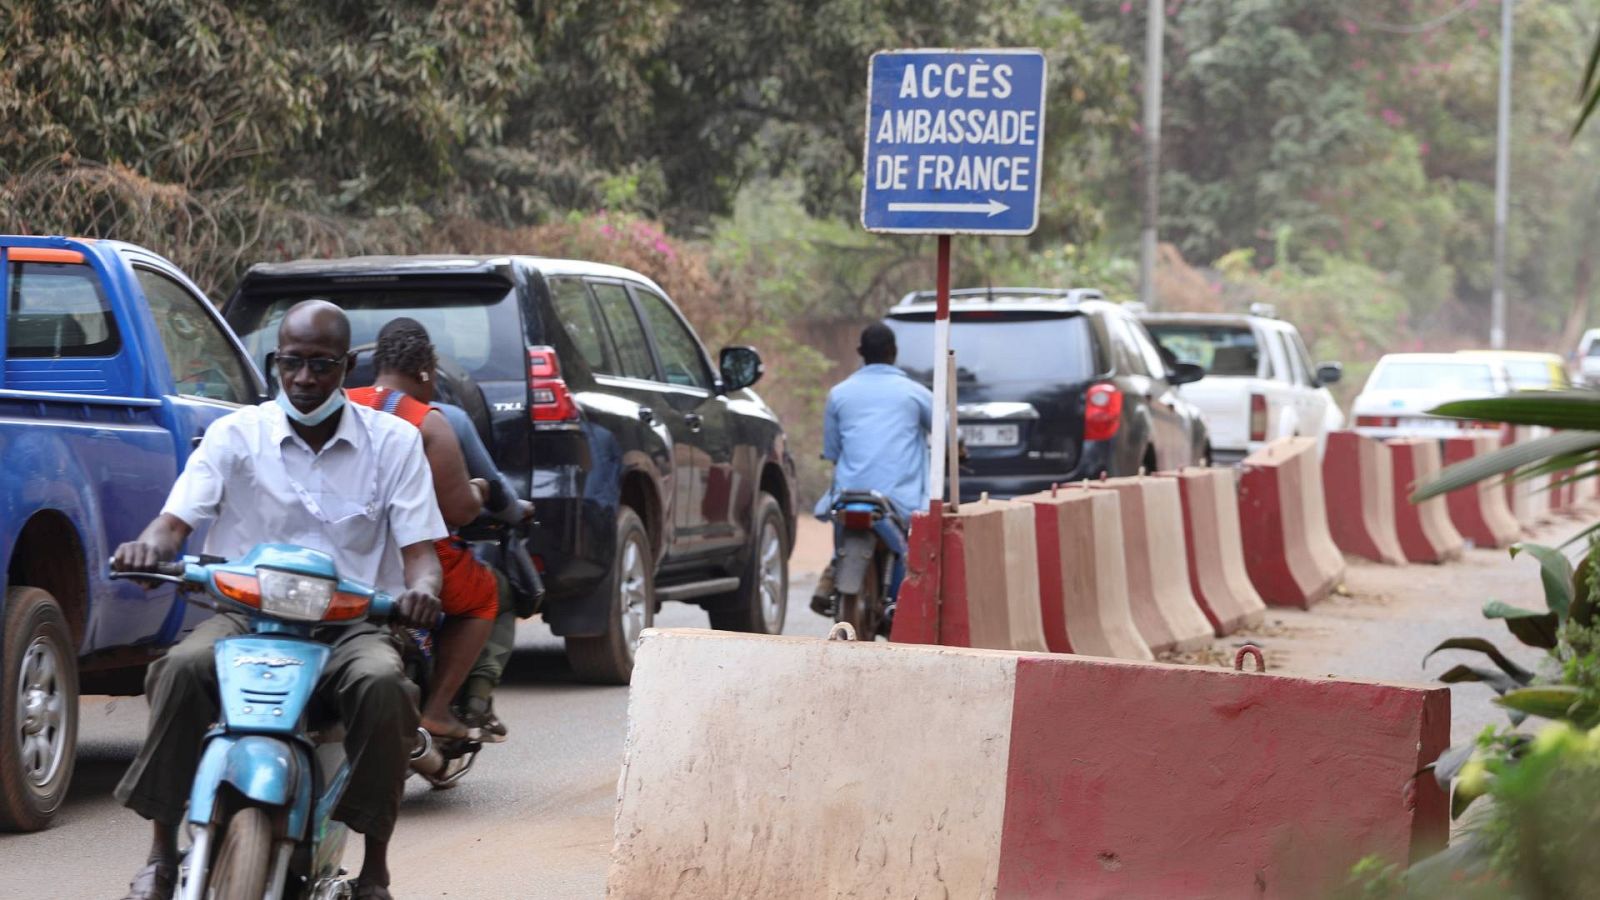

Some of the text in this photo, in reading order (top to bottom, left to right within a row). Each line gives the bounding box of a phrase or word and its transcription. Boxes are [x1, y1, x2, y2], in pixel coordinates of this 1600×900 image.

[899, 58, 1013, 99] ACCÈS
[876, 109, 1036, 145] AMBASSADE
[875, 155, 1030, 191] DE FRANCE
